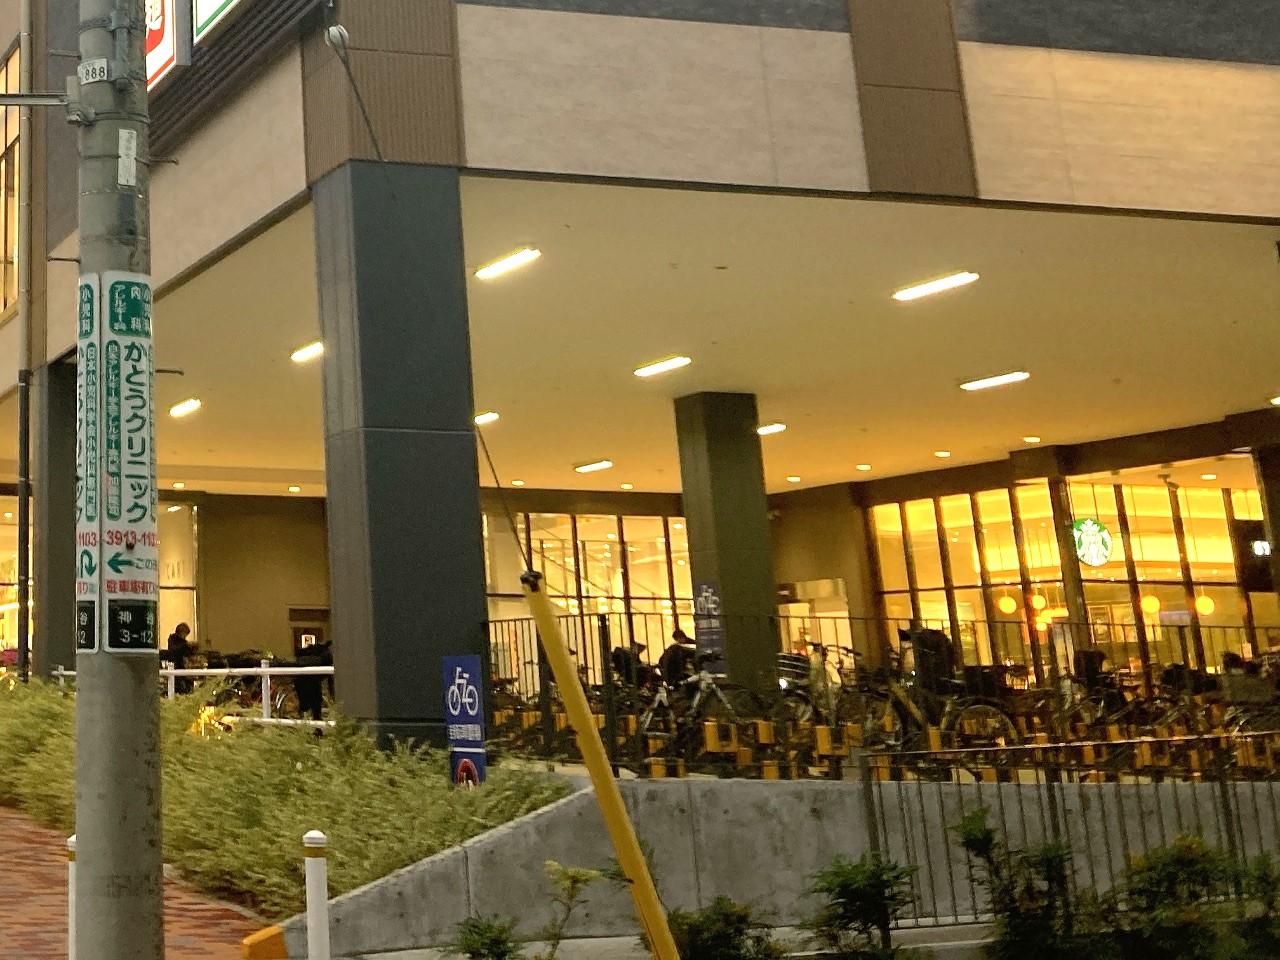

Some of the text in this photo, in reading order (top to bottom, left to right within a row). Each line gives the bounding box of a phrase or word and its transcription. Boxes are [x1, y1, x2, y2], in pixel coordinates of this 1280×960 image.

[85, 66, 105, 81] 888
[124, 341, 148, 523] かとうクリニック
[120, 629, 154, 643] 3-12
